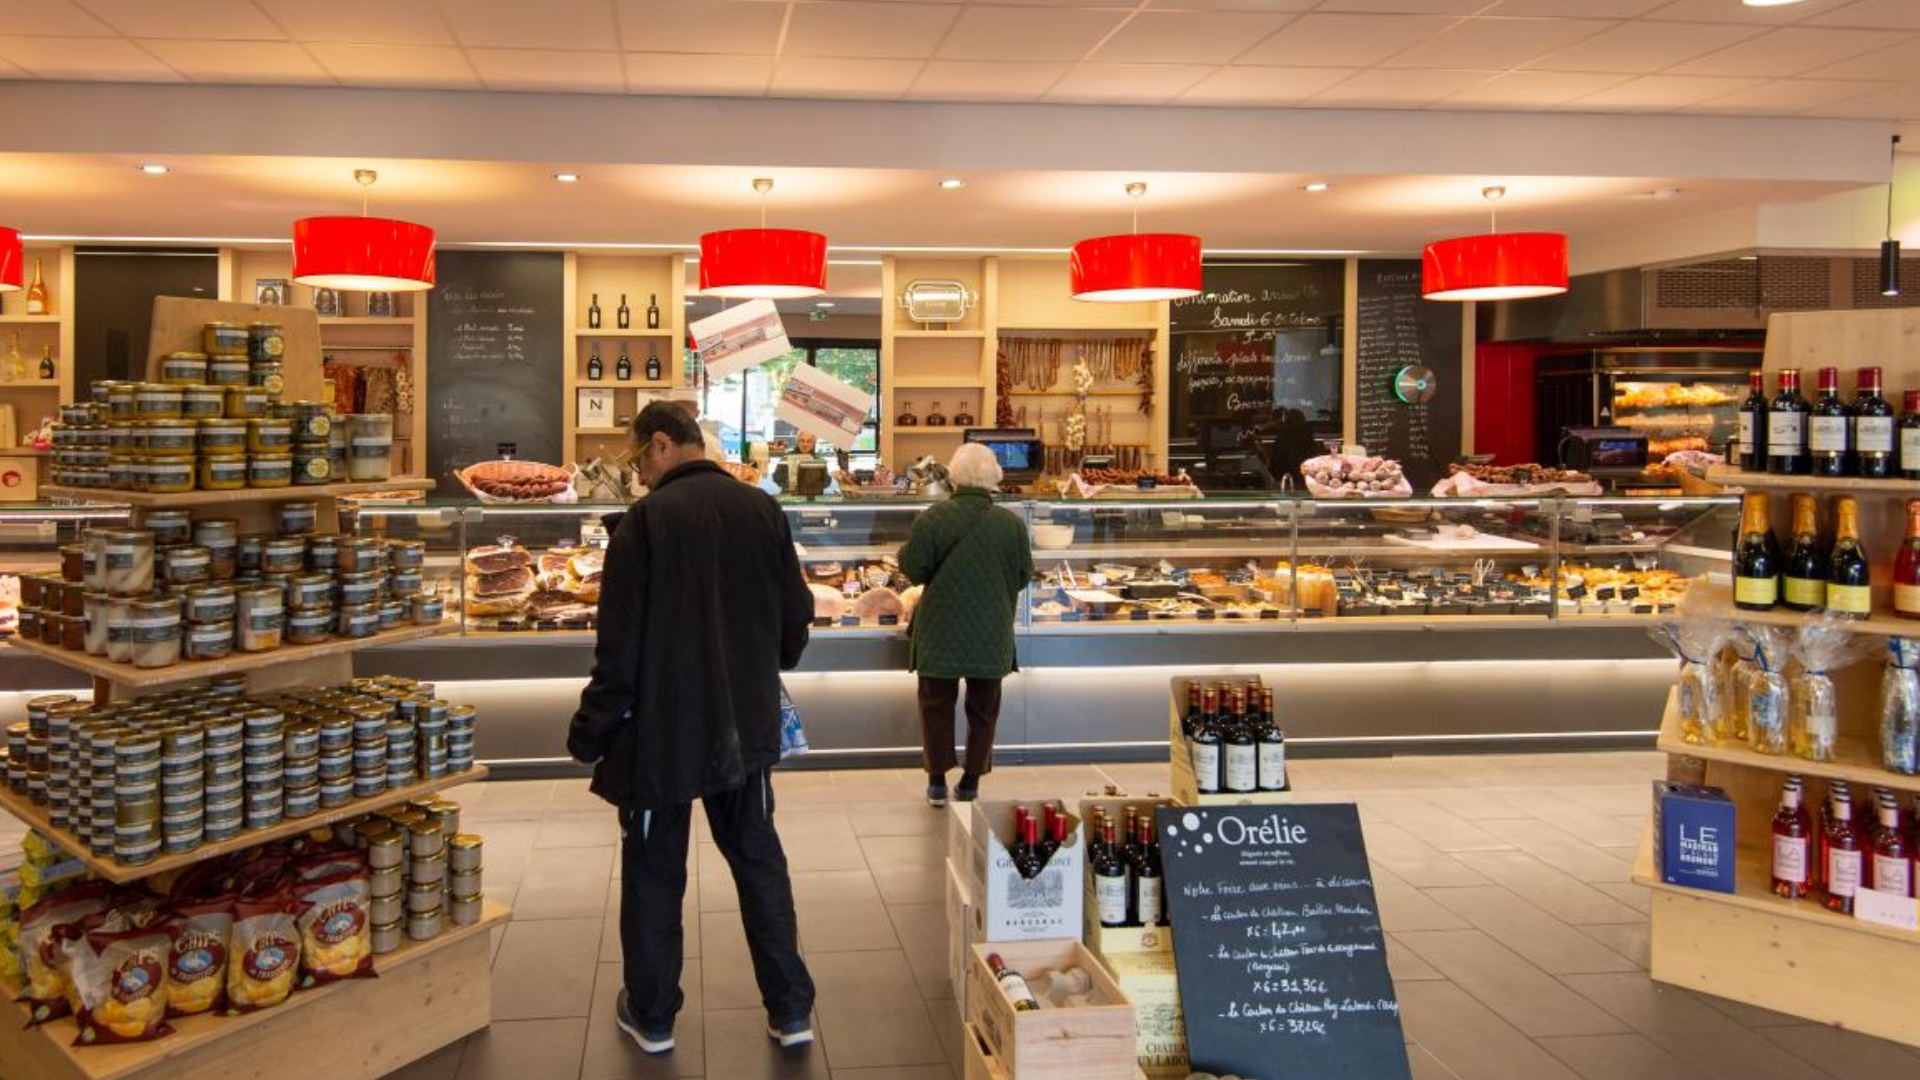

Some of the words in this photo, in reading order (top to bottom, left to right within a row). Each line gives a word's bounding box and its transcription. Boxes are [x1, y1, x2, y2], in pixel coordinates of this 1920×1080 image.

[1210, 306, 1258, 328] Samedi
[1260, 311, 1271, 326] 6
[590, 398, 603, 411] N
[1217, 813, 1308, 846] Orélie
[1680, 823, 1718, 846] LE
[1183, 880, 1214, 898] Notre
